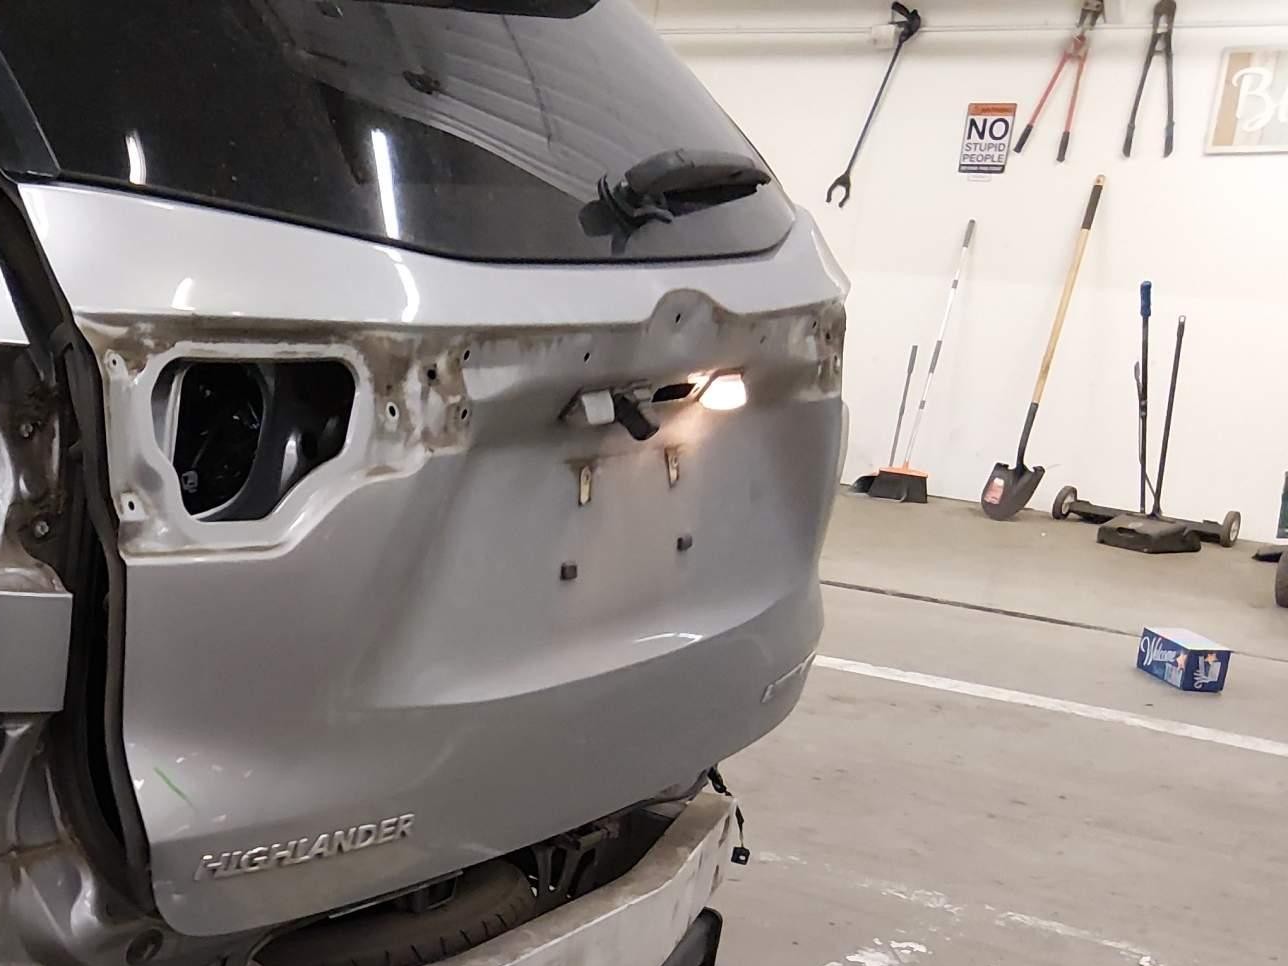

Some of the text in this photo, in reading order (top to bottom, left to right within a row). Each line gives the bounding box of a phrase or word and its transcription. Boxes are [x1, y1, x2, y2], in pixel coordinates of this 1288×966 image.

[966, 118, 1010, 141] NO
[964, 142, 1006, 152] STUPID
[962, 154, 1005, 163] PEOPLE
[194, 813, 415, 881] HIGHLANDER
